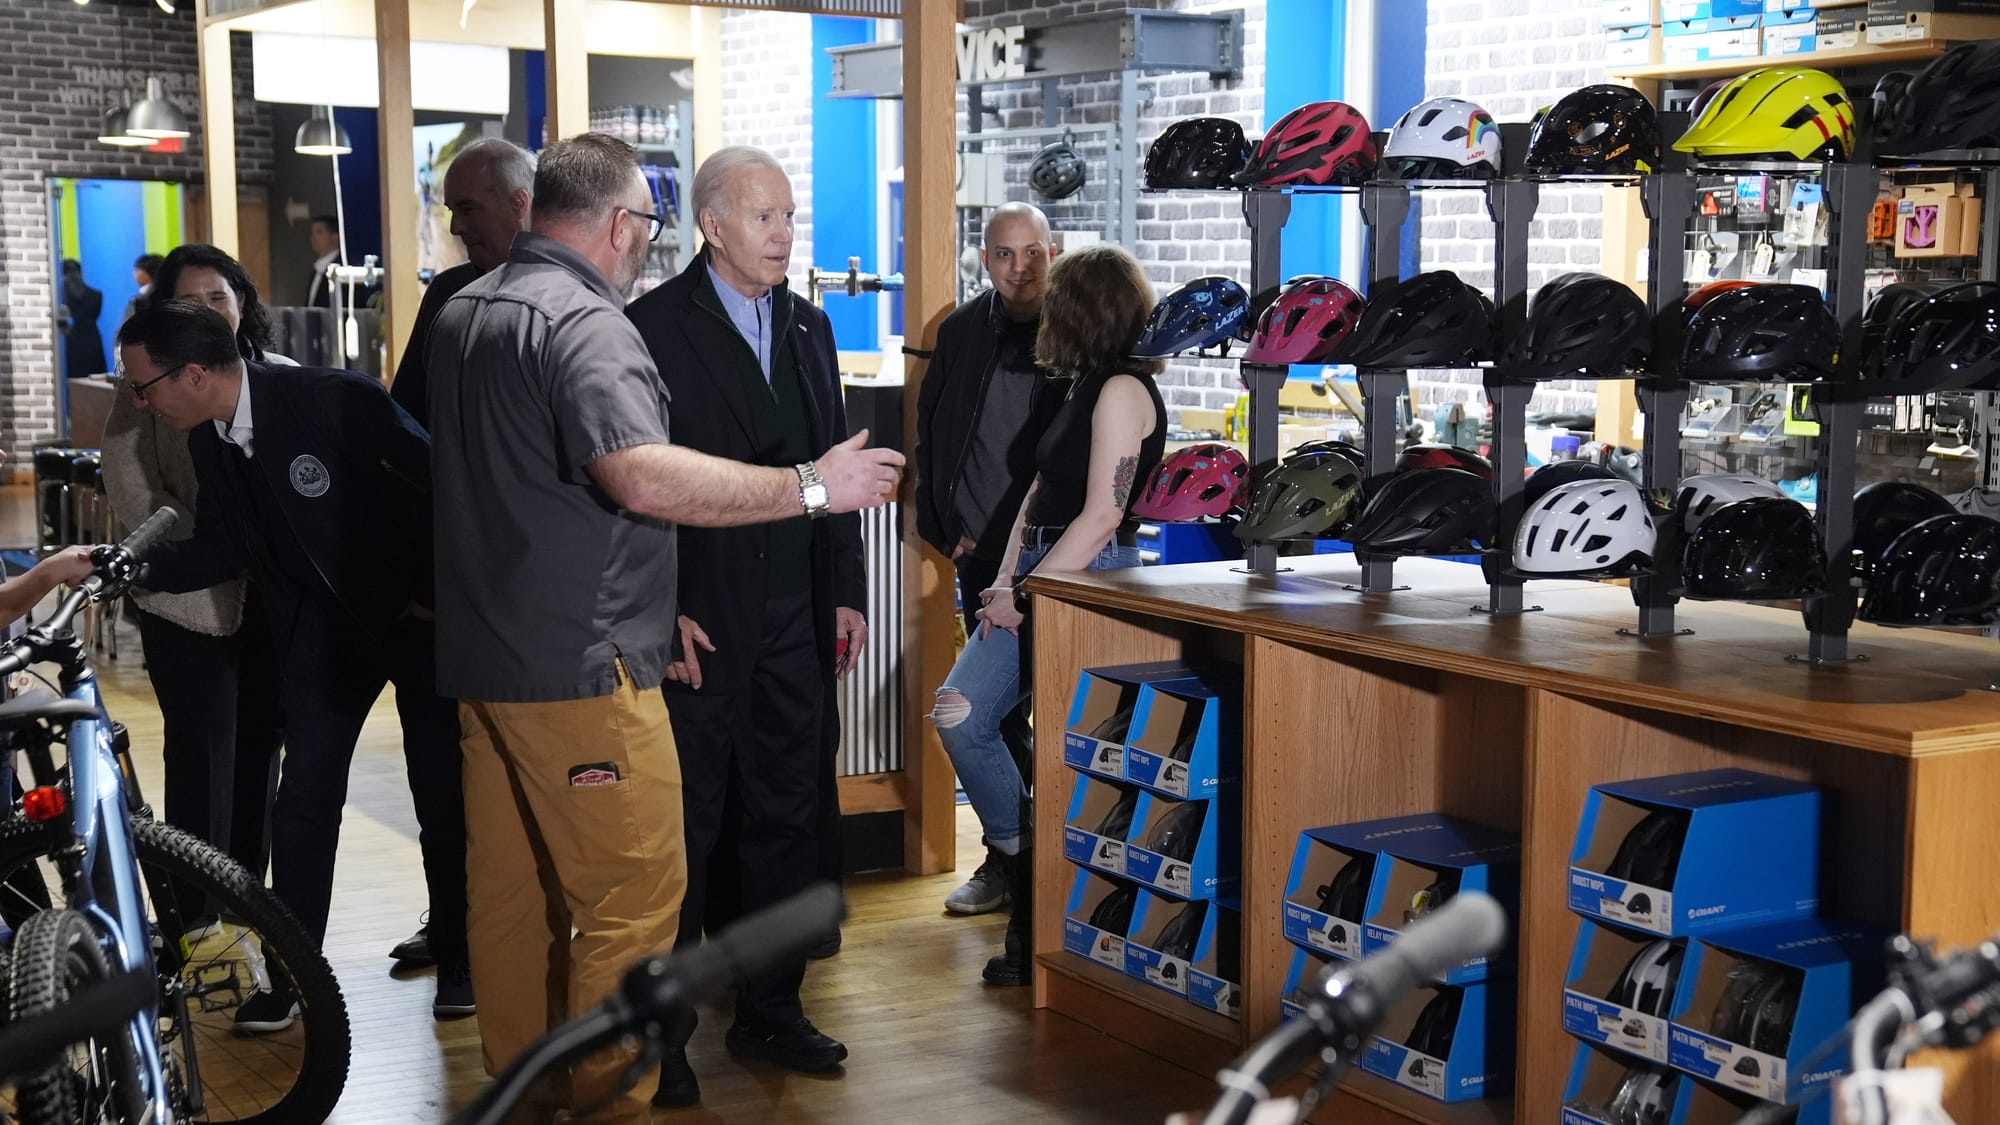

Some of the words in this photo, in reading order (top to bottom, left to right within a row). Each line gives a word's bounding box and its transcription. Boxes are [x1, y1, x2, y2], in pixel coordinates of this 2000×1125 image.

[1466, 149, 1485, 160] LAZER
[1215, 305, 1244, 332] LAZER
[1325, 487, 1356, 517] LAZER
[1572, 874, 1590, 888] ROOST
[1590, 878, 1605, 892] MIPS
[1287, 907, 1301, 921] ROOST
[1300, 911, 1312, 924] MIPS
[1695, 905, 1726, 917] GIANT
[1367, 928, 1382, 940] RELAY
[1566, 996, 1582, 1010] PATH
[1582, 1002, 1598, 1015] MIPS
[1672, 1030, 1689, 1044] PATH
[1689, 1035, 1705, 1050] MIPS
